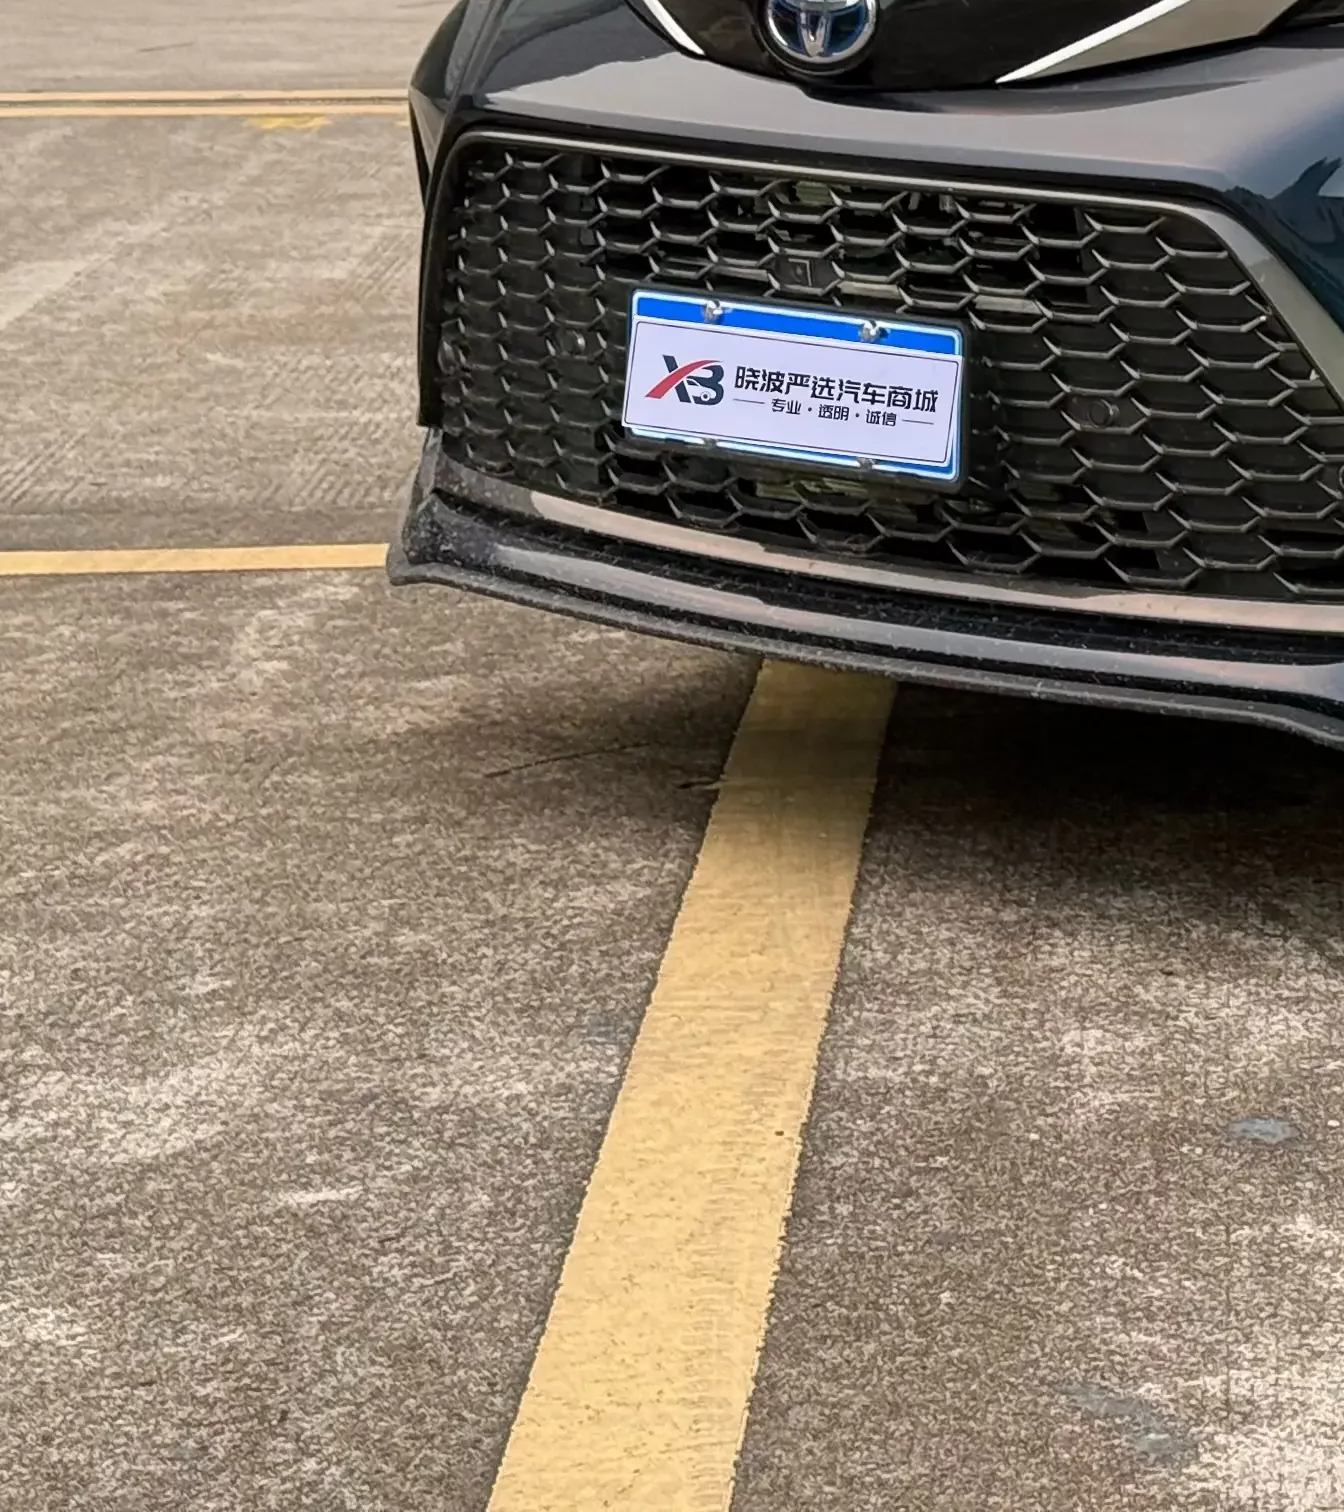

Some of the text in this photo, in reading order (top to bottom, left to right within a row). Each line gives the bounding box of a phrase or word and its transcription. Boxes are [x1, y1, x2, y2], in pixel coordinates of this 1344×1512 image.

[734, 365, 939, 413] 晓波严选汽车商城
